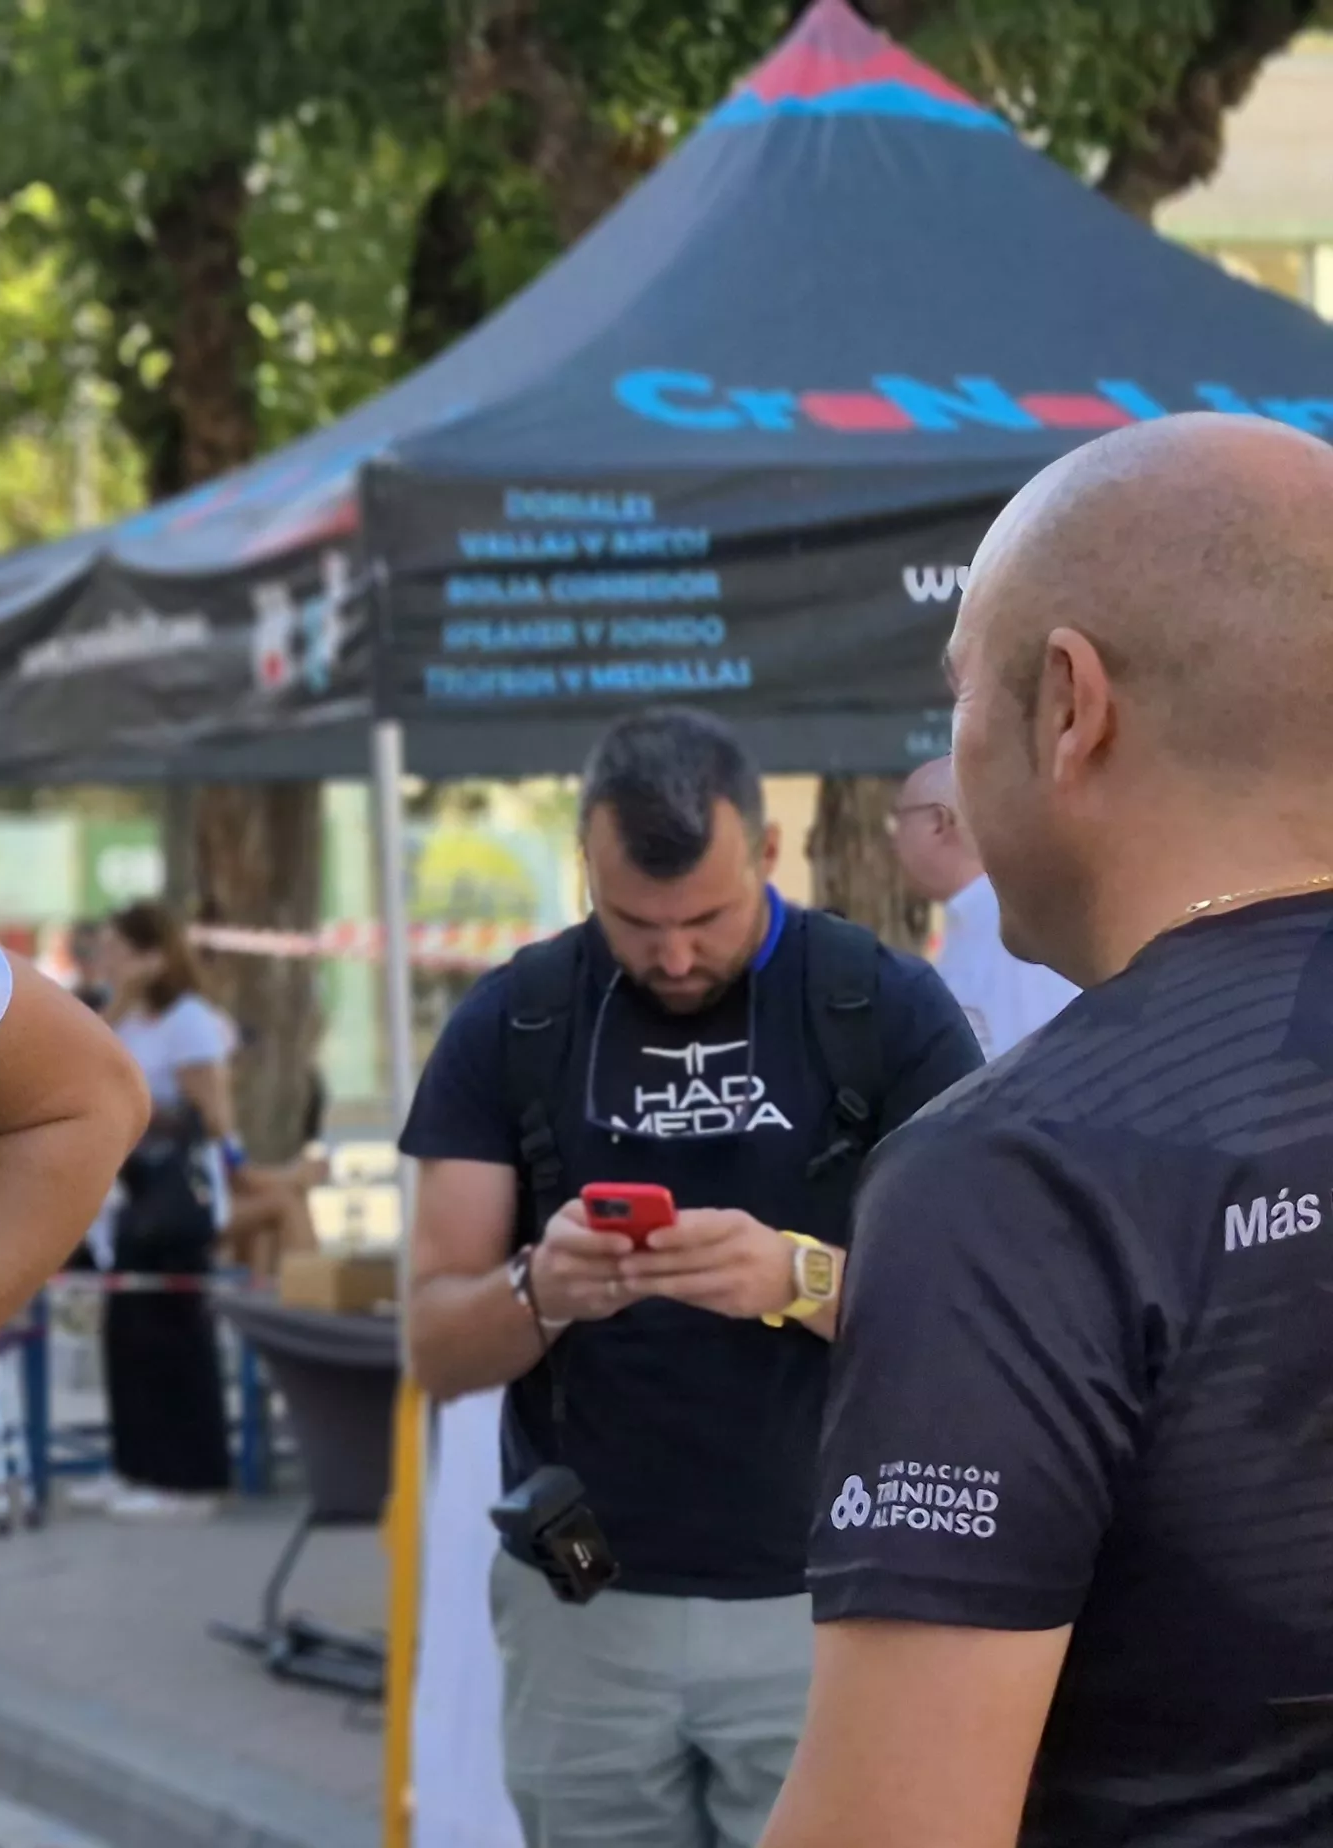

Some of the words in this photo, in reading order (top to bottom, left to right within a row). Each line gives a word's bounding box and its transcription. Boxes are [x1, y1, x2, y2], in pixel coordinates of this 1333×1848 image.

[635, 1075, 765, 1113] HAD
[610, 1102, 793, 1143] MEDA
[1224, 1187, 1321, 1252] Más
